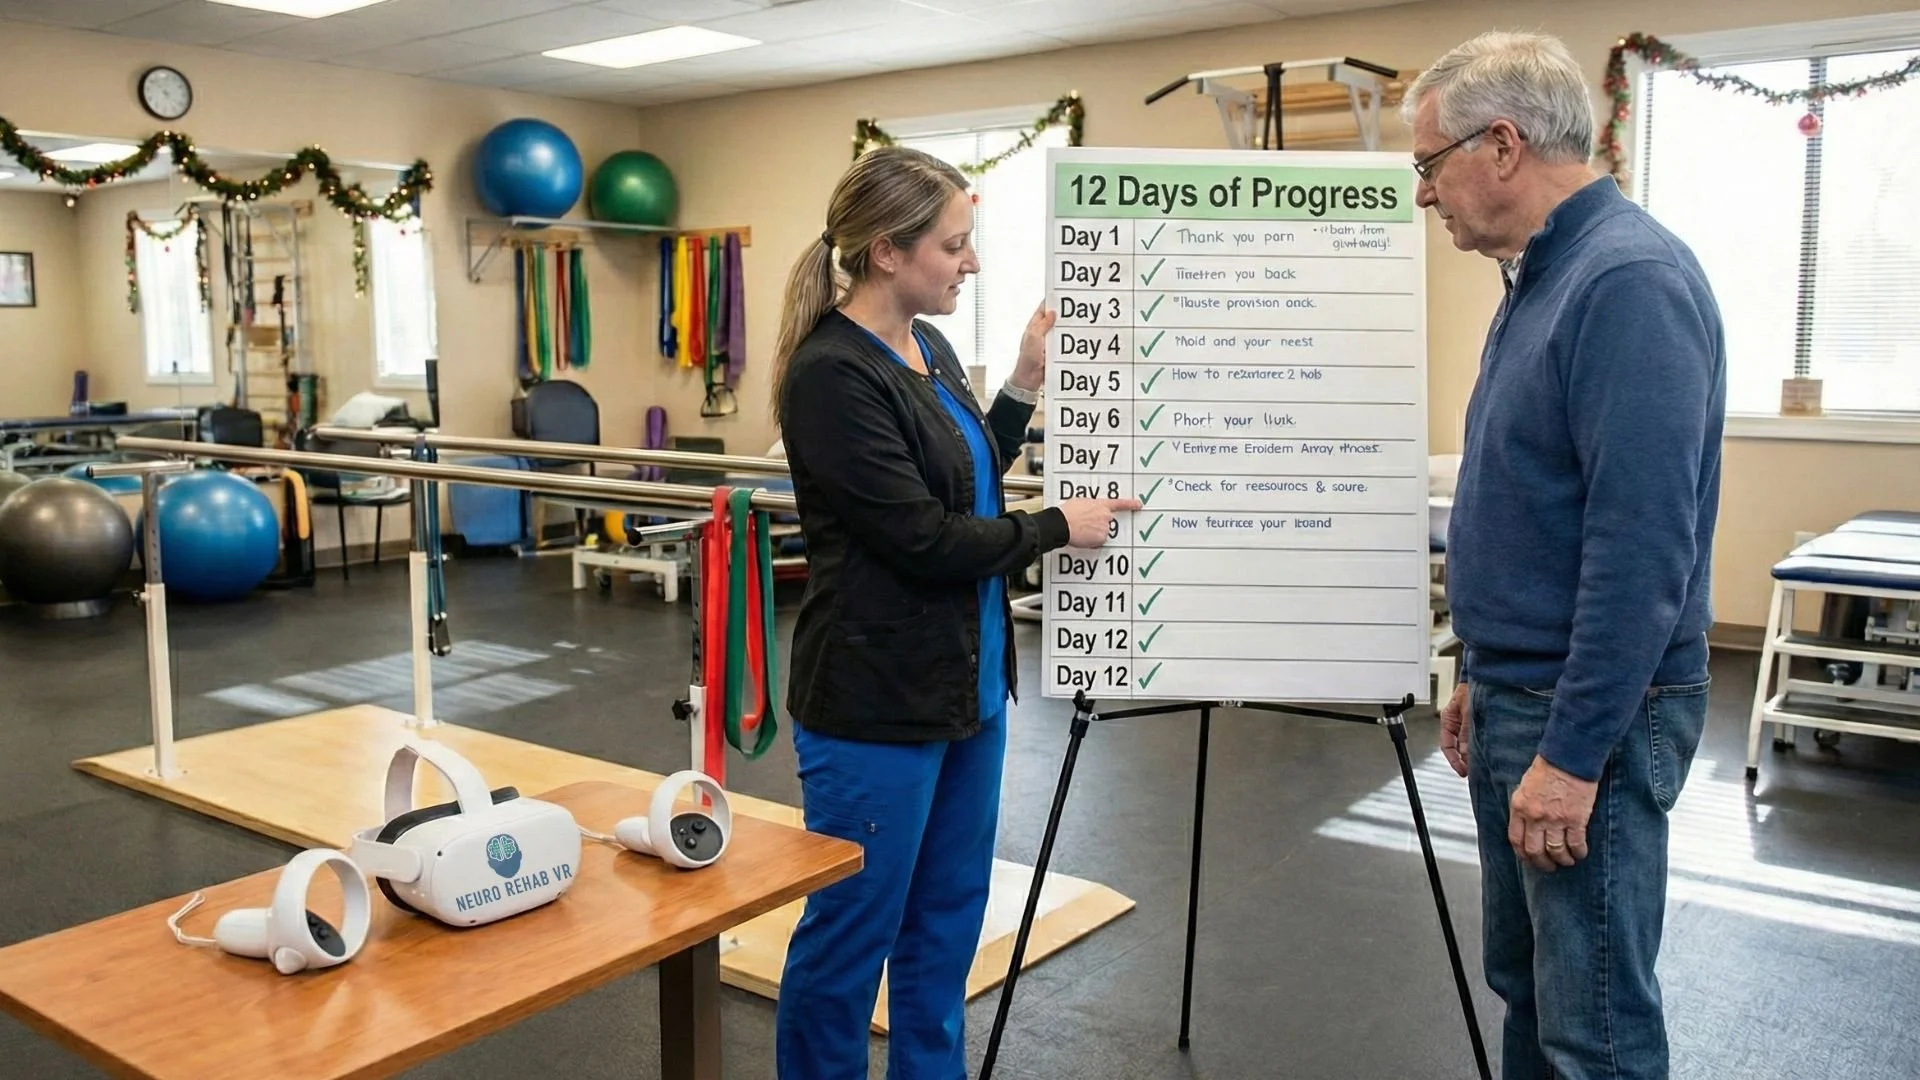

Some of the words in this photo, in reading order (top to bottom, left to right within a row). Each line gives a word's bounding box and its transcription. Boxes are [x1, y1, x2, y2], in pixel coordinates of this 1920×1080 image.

[1071, 174, 1107, 206] 12
[1118, 175, 1198, 214] Days
[1209, 176, 1242, 207] of
[1252, 177, 1398, 217] Progress
[1061, 225, 1102, 251] Day
[1109, 225, 1119, 246] 1
[1176, 228, 1225, 245] Thank
[1233, 233, 1255, 246] you
[1061, 260, 1101, 287] Day
[1108, 261, 1121, 283] 2
[1234, 269, 1255, 282] you
[1264, 267, 1297, 280] back
[1060, 297, 1101, 324] Day
[1108, 297, 1121, 319] 3
[1226, 296, 1280, 311] provision
[1060, 333, 1101, 360] Day
[1107, 333, 1121, 356] 4
[1213, 336, 1236, 347] and
[1243, 338, 1272, 350] your
[1060, 369, 1101, 397] Day
[1108, 370, 1121, 392] 5
[1172, 368, 1198, 381] How
[1203, 368, 1220, 380] to
[1060, 406, 1101, 434] Day
[1107, 407, 1120, 429] 6
[1223, 415, 1254, 430] your
[1060, 443, 1100, 470] Day
[1107, 443, 1120, 465] 7
[1107, 481, 1120, 499] 8
[1220, 479, 1237, 491] for
[1316, 480, 1327, 493] &
[1108, 518, 1119, 539] 9
[1172, 516, 1198, 529] Now
[1260, 518, 1287, 531] your
[1058, 553, 1099, 580] Day
[1105, 554, 1129, 576] 10
[1058, 590, 1098, 617] Day
[1105, 591, 1125, 613] 11
[1057, 627, 1097, 654] Day
[1104, 628, 1128, 650] 12
[1056, 664, 1097, 691] Day
[1104, 665, 1128, 687] 12
[455, 885, 502, 912] NEURO
[504, 870, 550, 896] REHAB
[552, 863, 573, 881] VR
